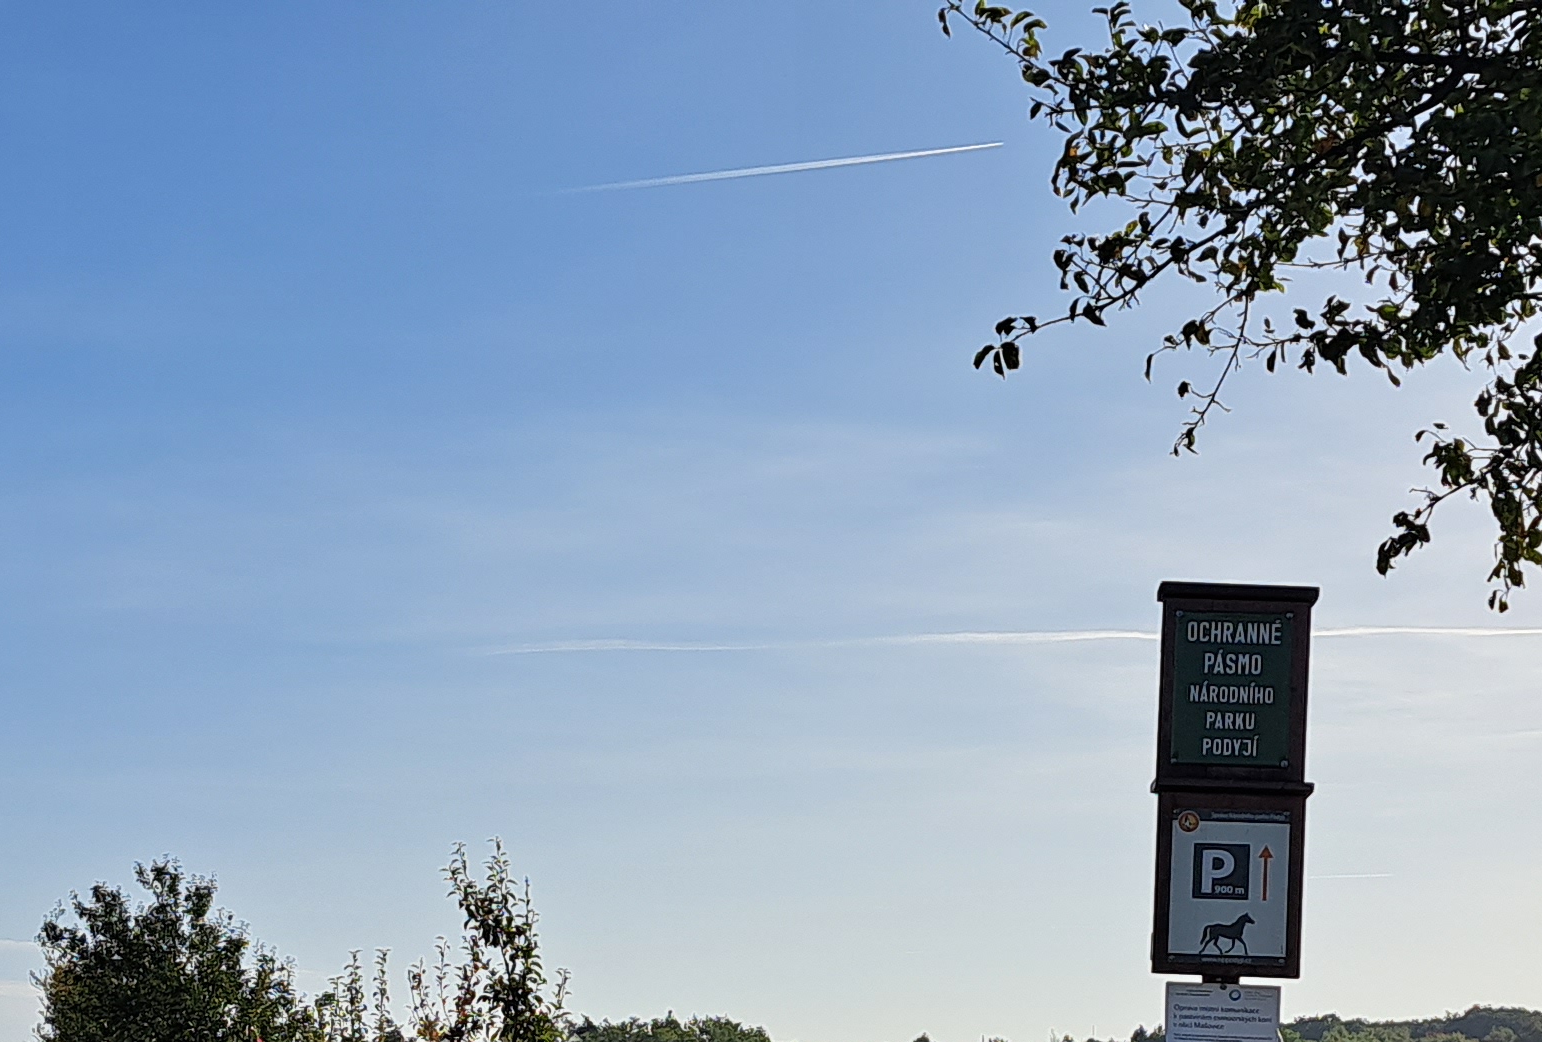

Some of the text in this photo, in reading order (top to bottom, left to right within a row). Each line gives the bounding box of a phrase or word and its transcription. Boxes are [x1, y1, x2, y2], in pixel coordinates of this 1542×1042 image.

[1187, 619, 1283, 645] OCHRANNÉ
[1203, 649, 1262, 675] PÁSMO
[1189, 680, 1274, 705] NÁRODNÍHO
[1205, 711, 1256, 730] PARKU
[1202, 735, 1259, 757] PODYJÍ
[1201, 849, 1235, 894] P
[1214, 885, 1245, 895] 900 m
